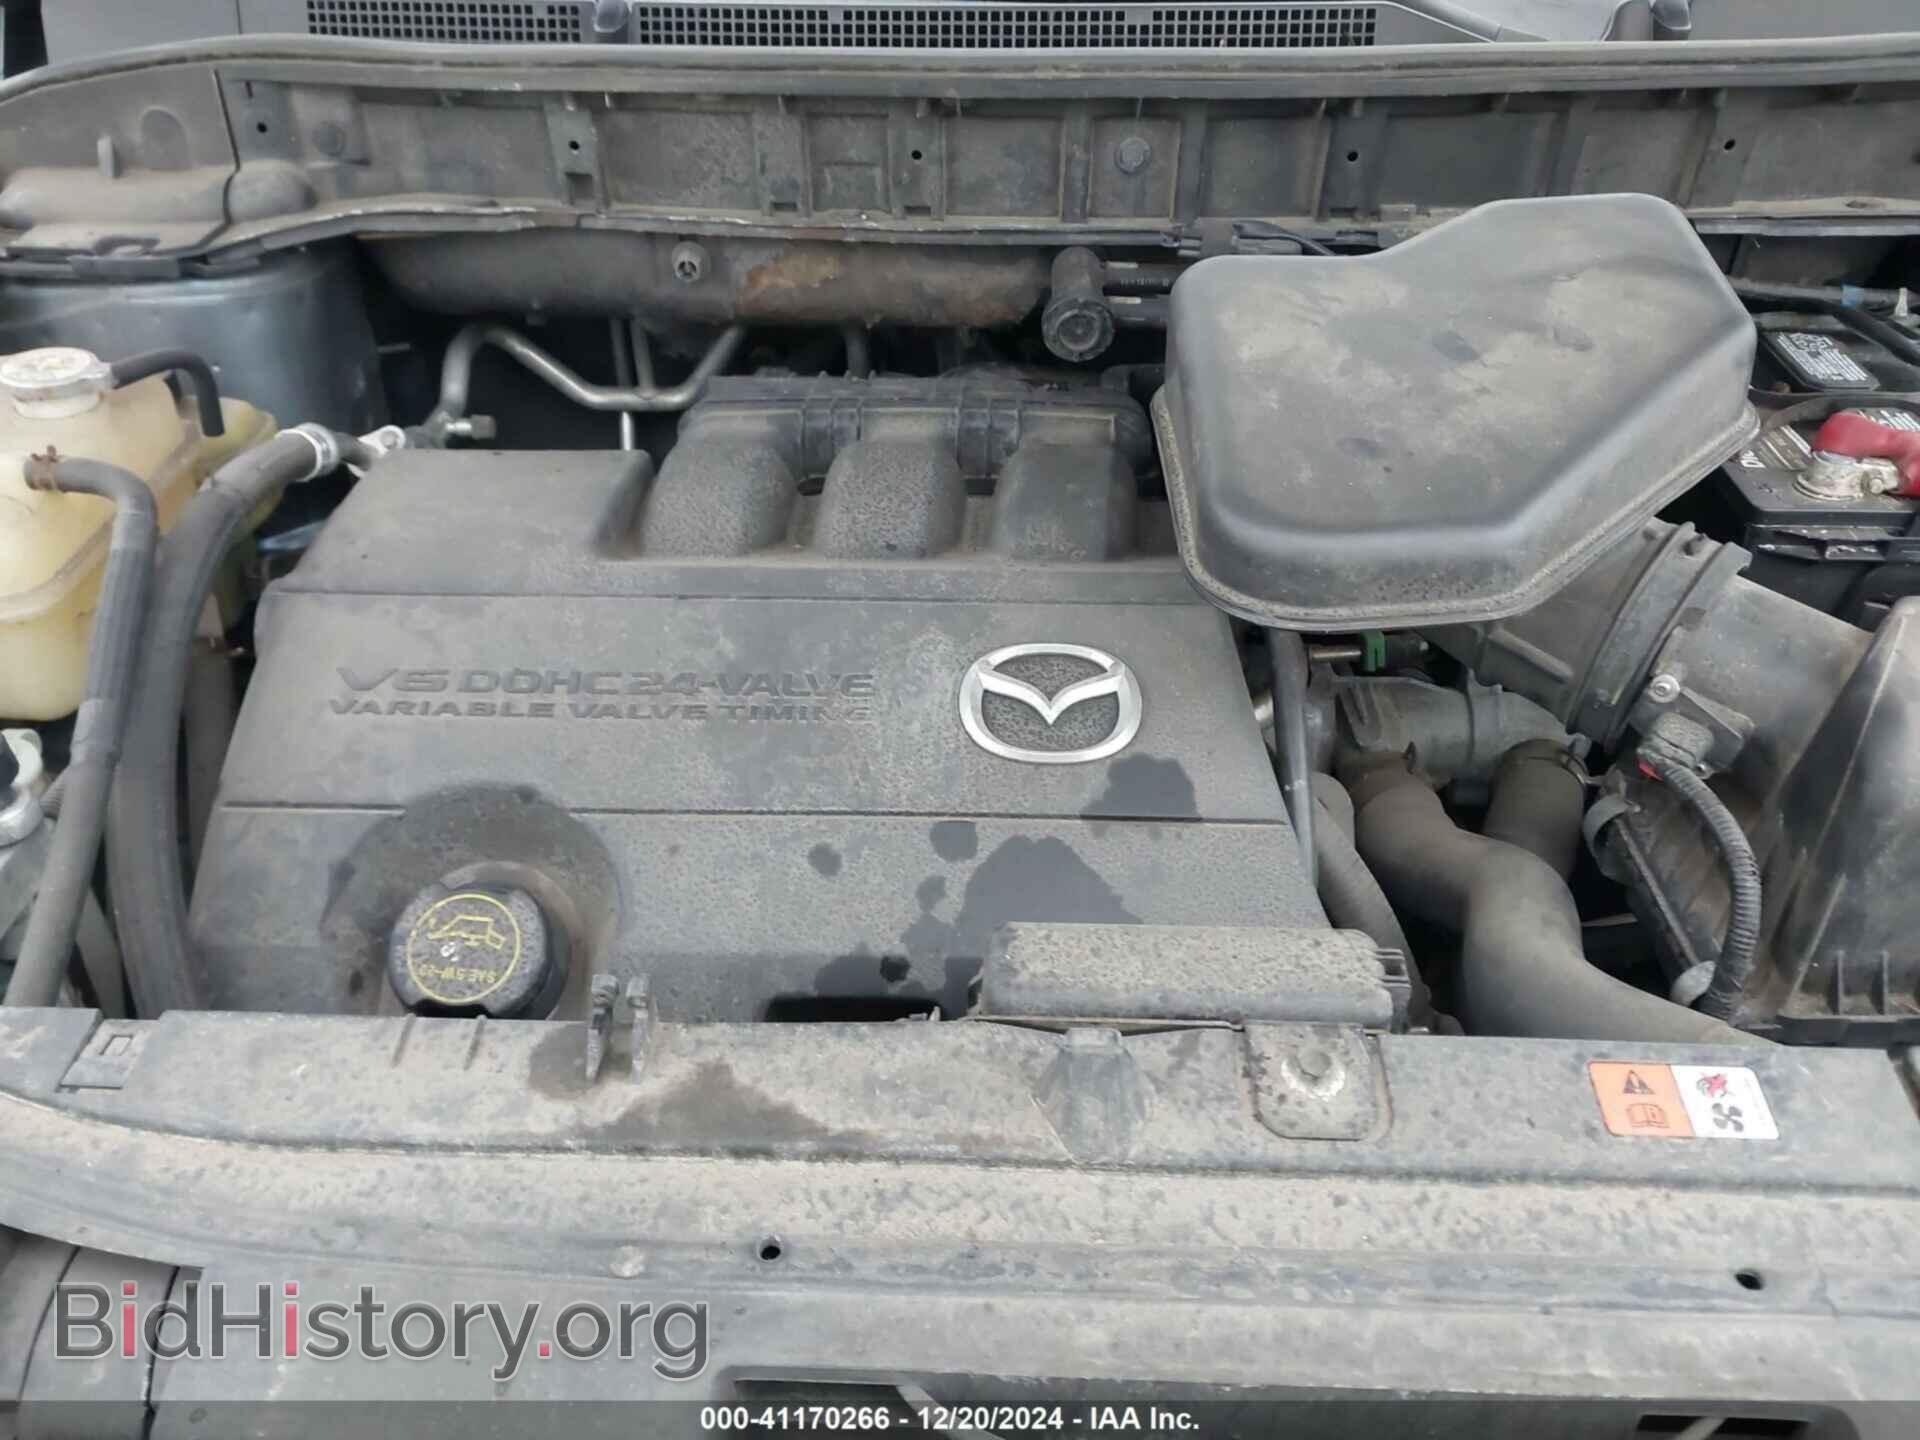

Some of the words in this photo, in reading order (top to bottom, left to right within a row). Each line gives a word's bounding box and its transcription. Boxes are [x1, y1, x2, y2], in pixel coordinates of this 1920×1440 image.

[456, 668, 623, 696] DOHC
[623, 671, 877, 698] 24-VALVE
[329, 700, 556, 719] VARIABLE
[568, 702, 708, 721] VALVE
[716, 704, 875, 724] TIMING
